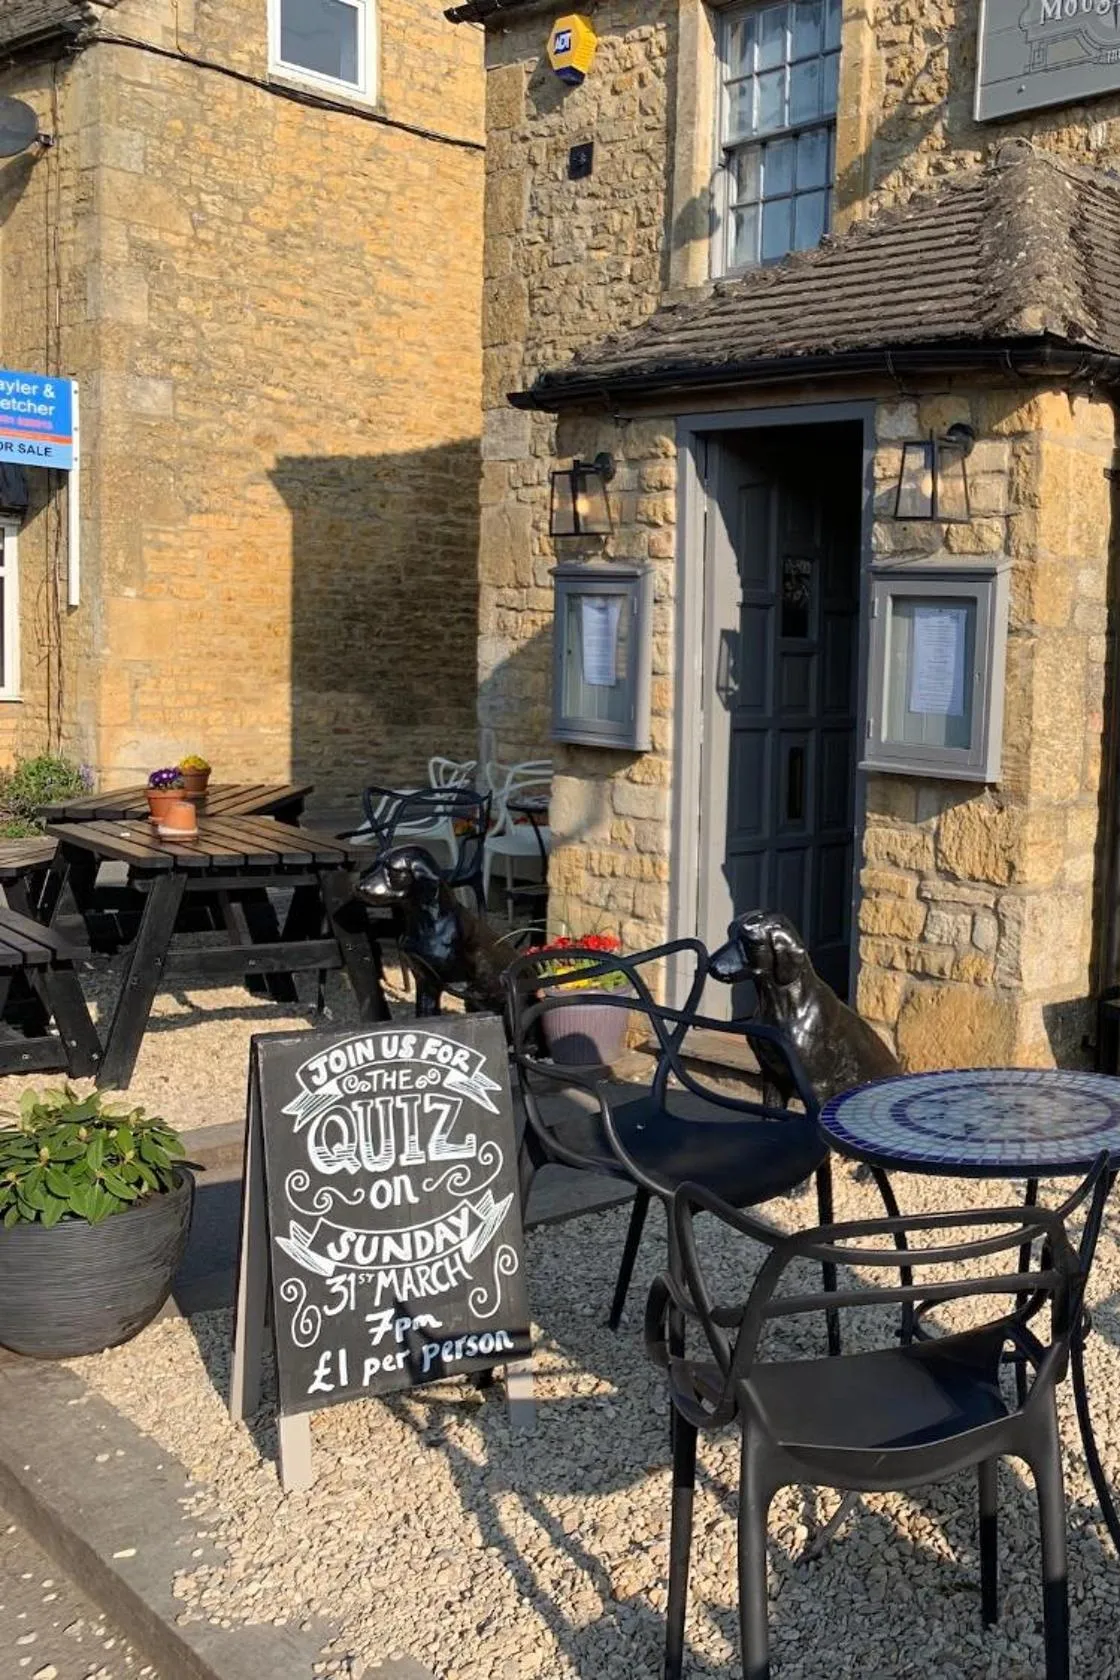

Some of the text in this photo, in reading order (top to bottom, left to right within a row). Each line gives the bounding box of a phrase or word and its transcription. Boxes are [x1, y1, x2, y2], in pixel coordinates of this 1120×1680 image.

[43, 383, 56, 399] &
[18, 443, 53, 458] SALE
[308, 1034, 471, 1086] JOIN US FOR
[365, 1069, 415, 1092] THE
[307, 1093, 477, 1175] QUIZ
[326, 1207, 469, 1265] SUNDAY
[373, 1252, 473, 1307] MARCH
[365, 1308, 443, 1346] 7pm
[307, 1329, 515, 1394] £1 per person
